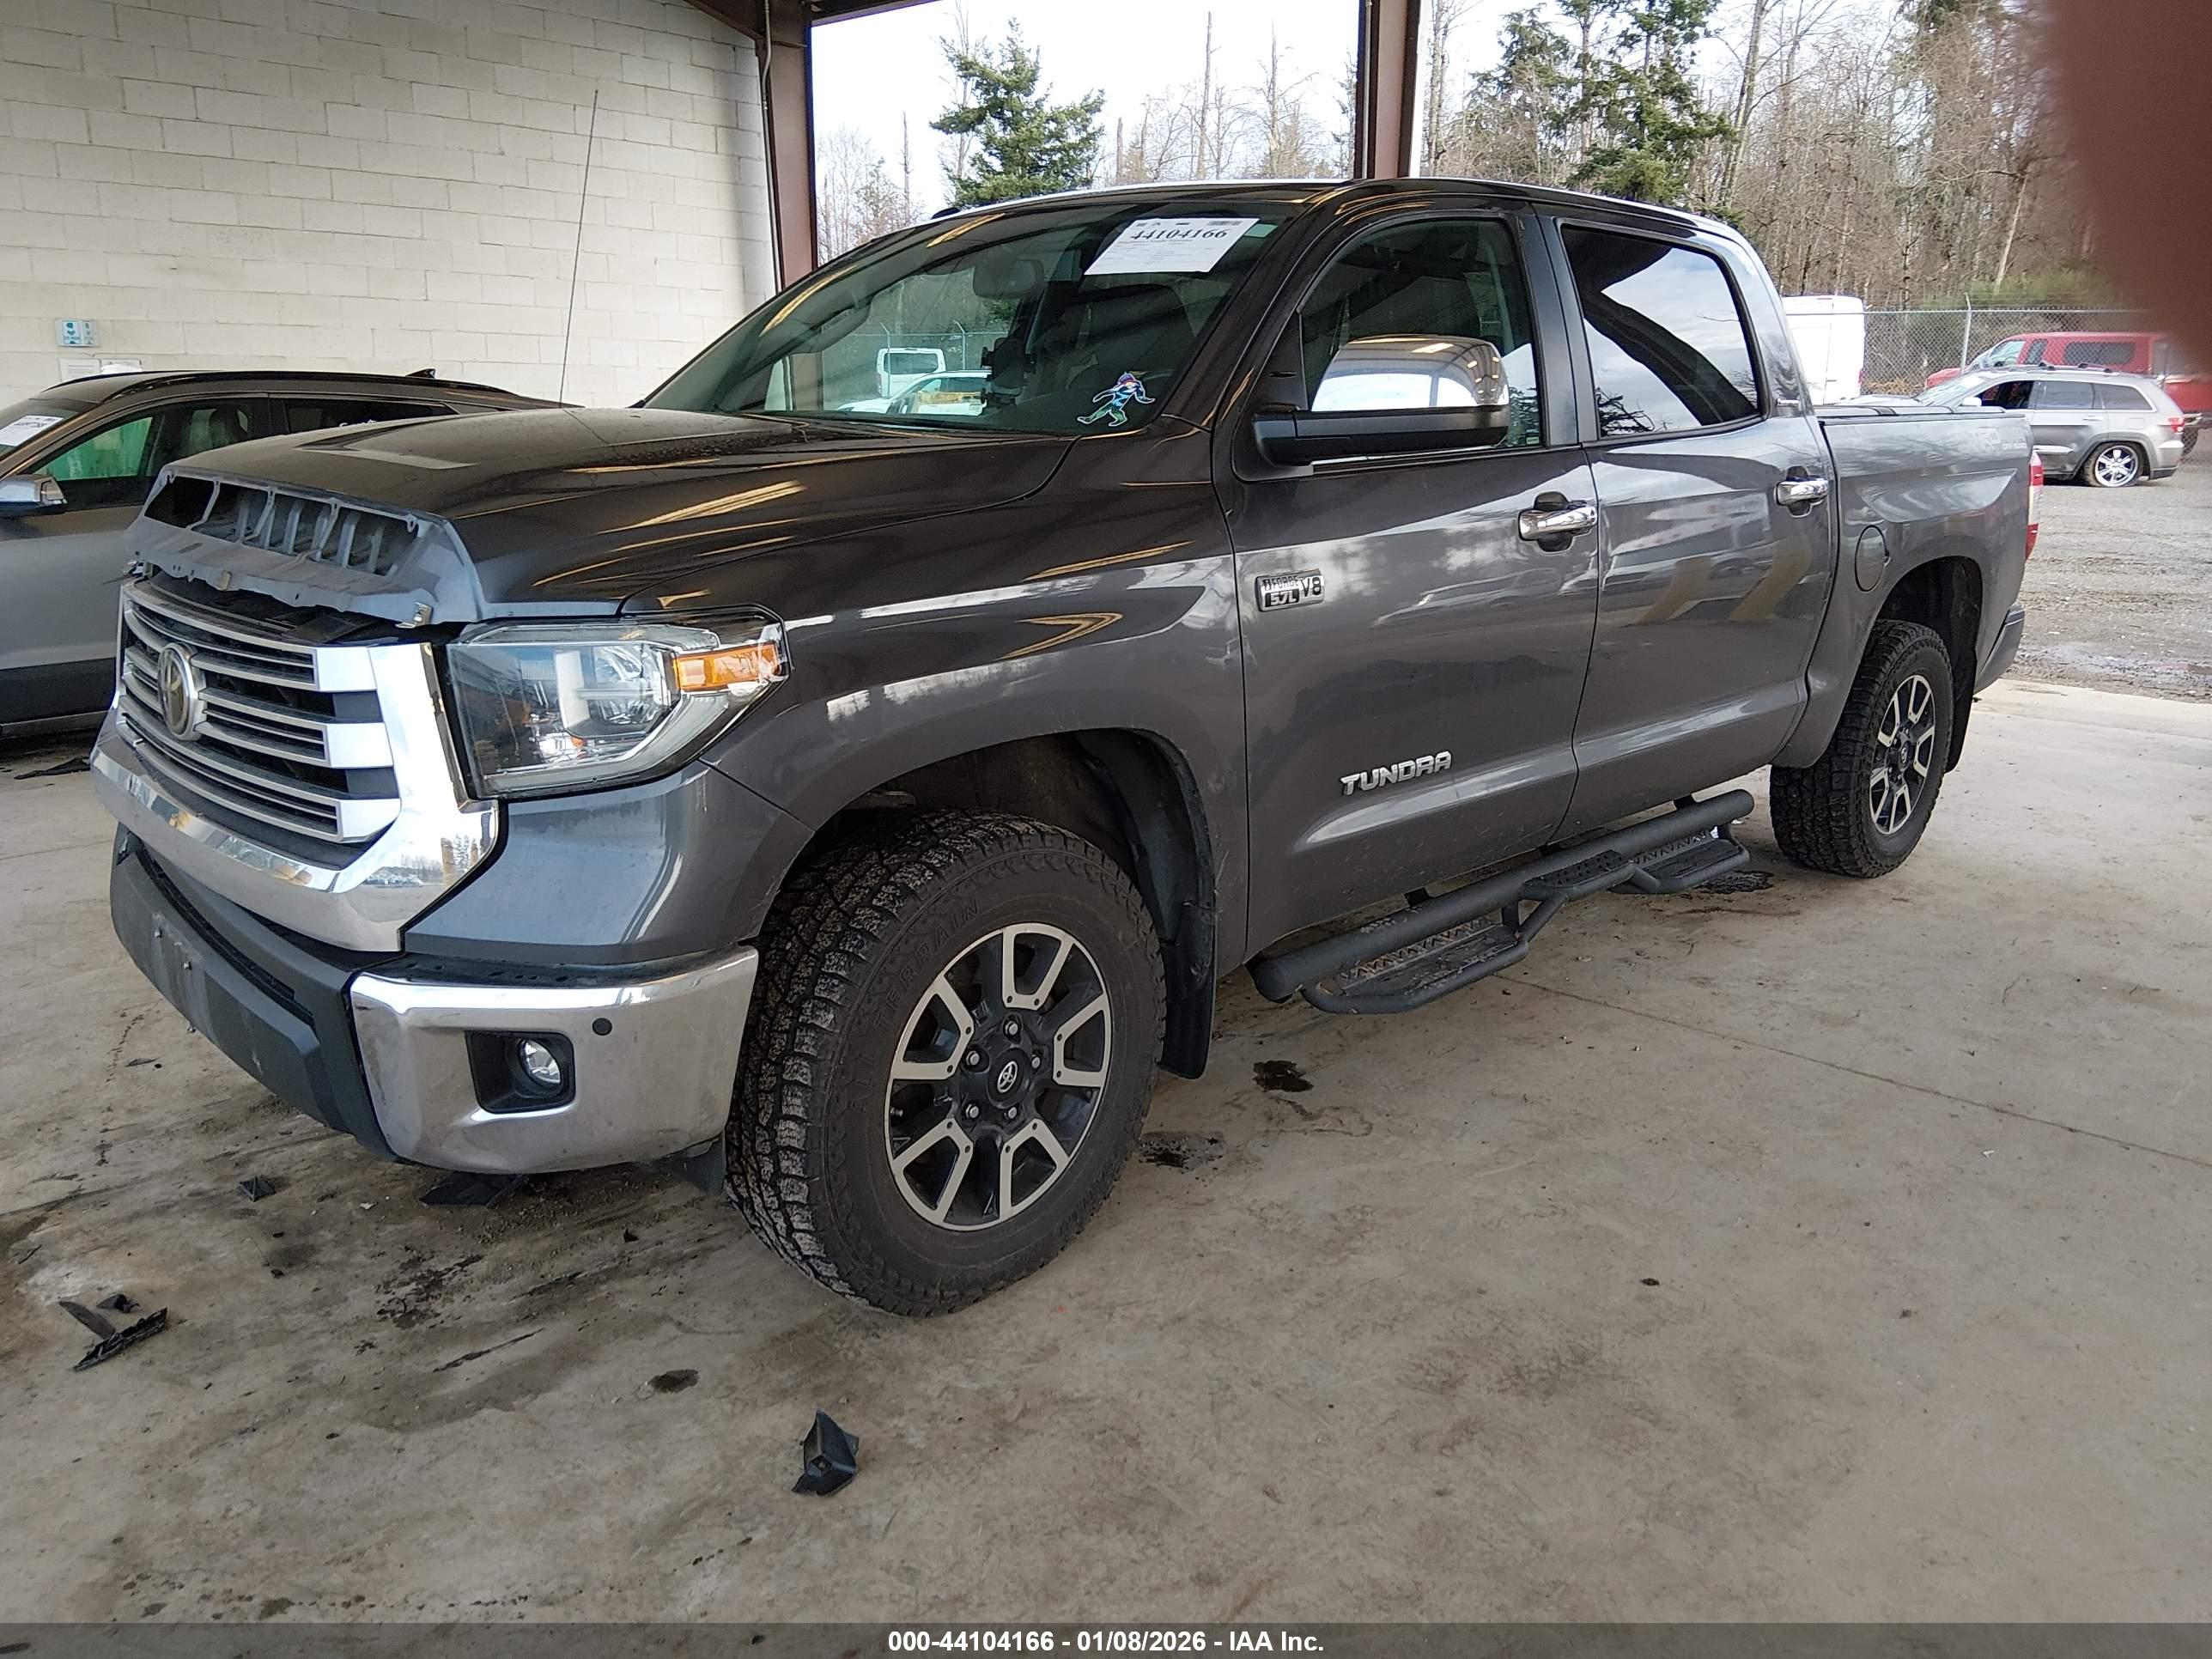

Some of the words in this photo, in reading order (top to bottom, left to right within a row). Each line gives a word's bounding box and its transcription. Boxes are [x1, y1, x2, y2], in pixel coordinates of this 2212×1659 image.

[1130, 228, 1230, 240] 44104166
[1301, 576, 1322, 598] V8
[1340, 750, 1453, 795] TUNDRA
